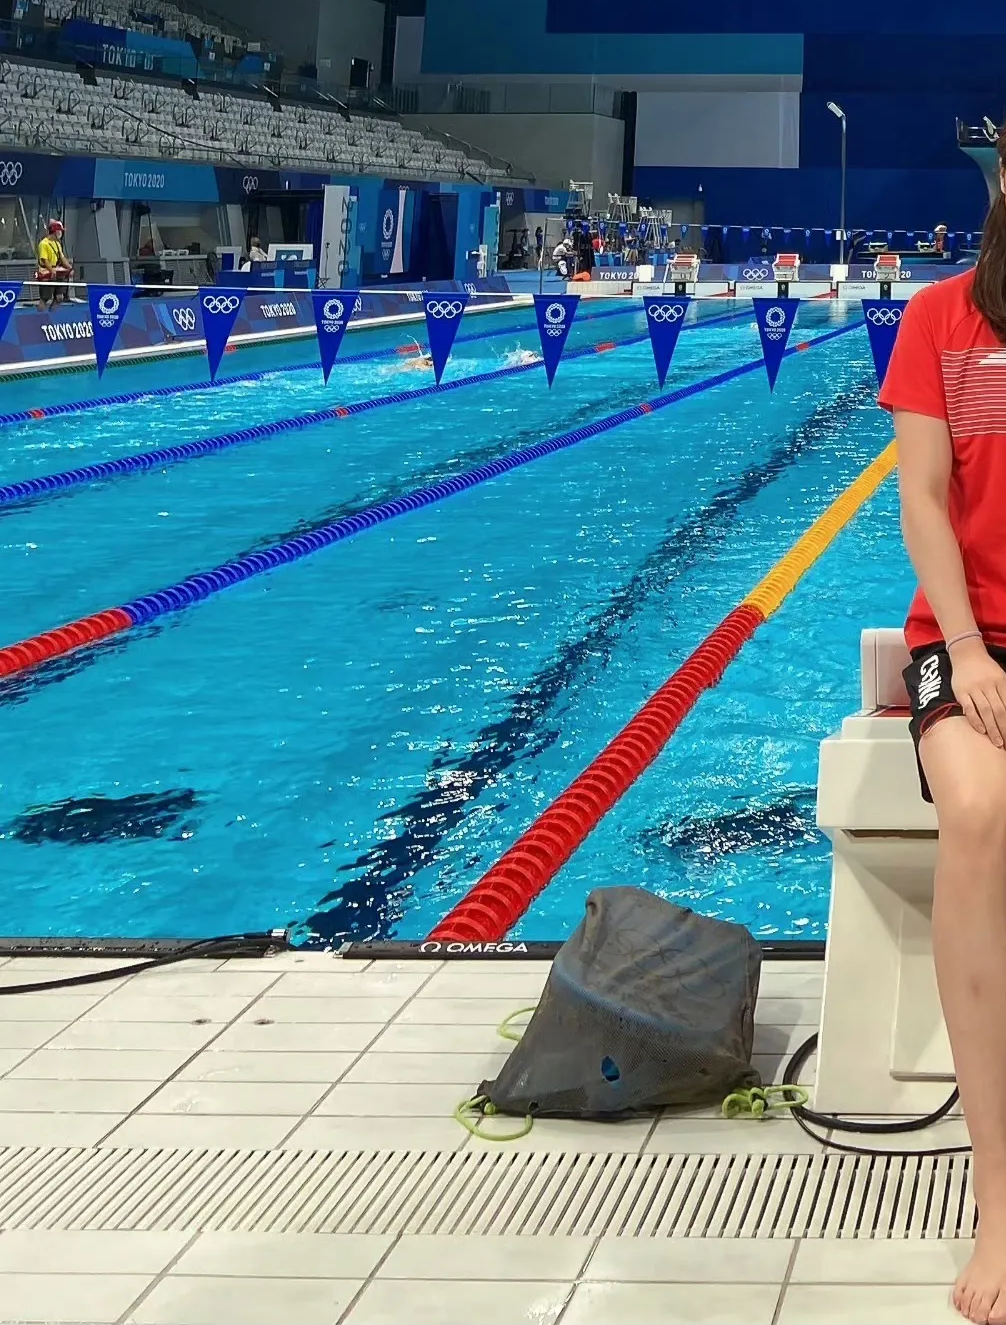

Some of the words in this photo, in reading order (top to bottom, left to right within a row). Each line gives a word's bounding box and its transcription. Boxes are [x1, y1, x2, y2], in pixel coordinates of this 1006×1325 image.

[124, 172, 147, 187] TOKYO
[147, 174, 165, 189] 2020
[600, 271, 627, 280] TOKYO
[628, 271, 639, 280] 20
[900, 270, 912, 279] 20
[260, 303, 282, 318] TOKYO
[281, 302, 296, 317] 2020
[41, 322, 74, 342] TOKYO
[918, 654, 942, 710] CHINA
[446, 942, 529, 953] OMEGA
